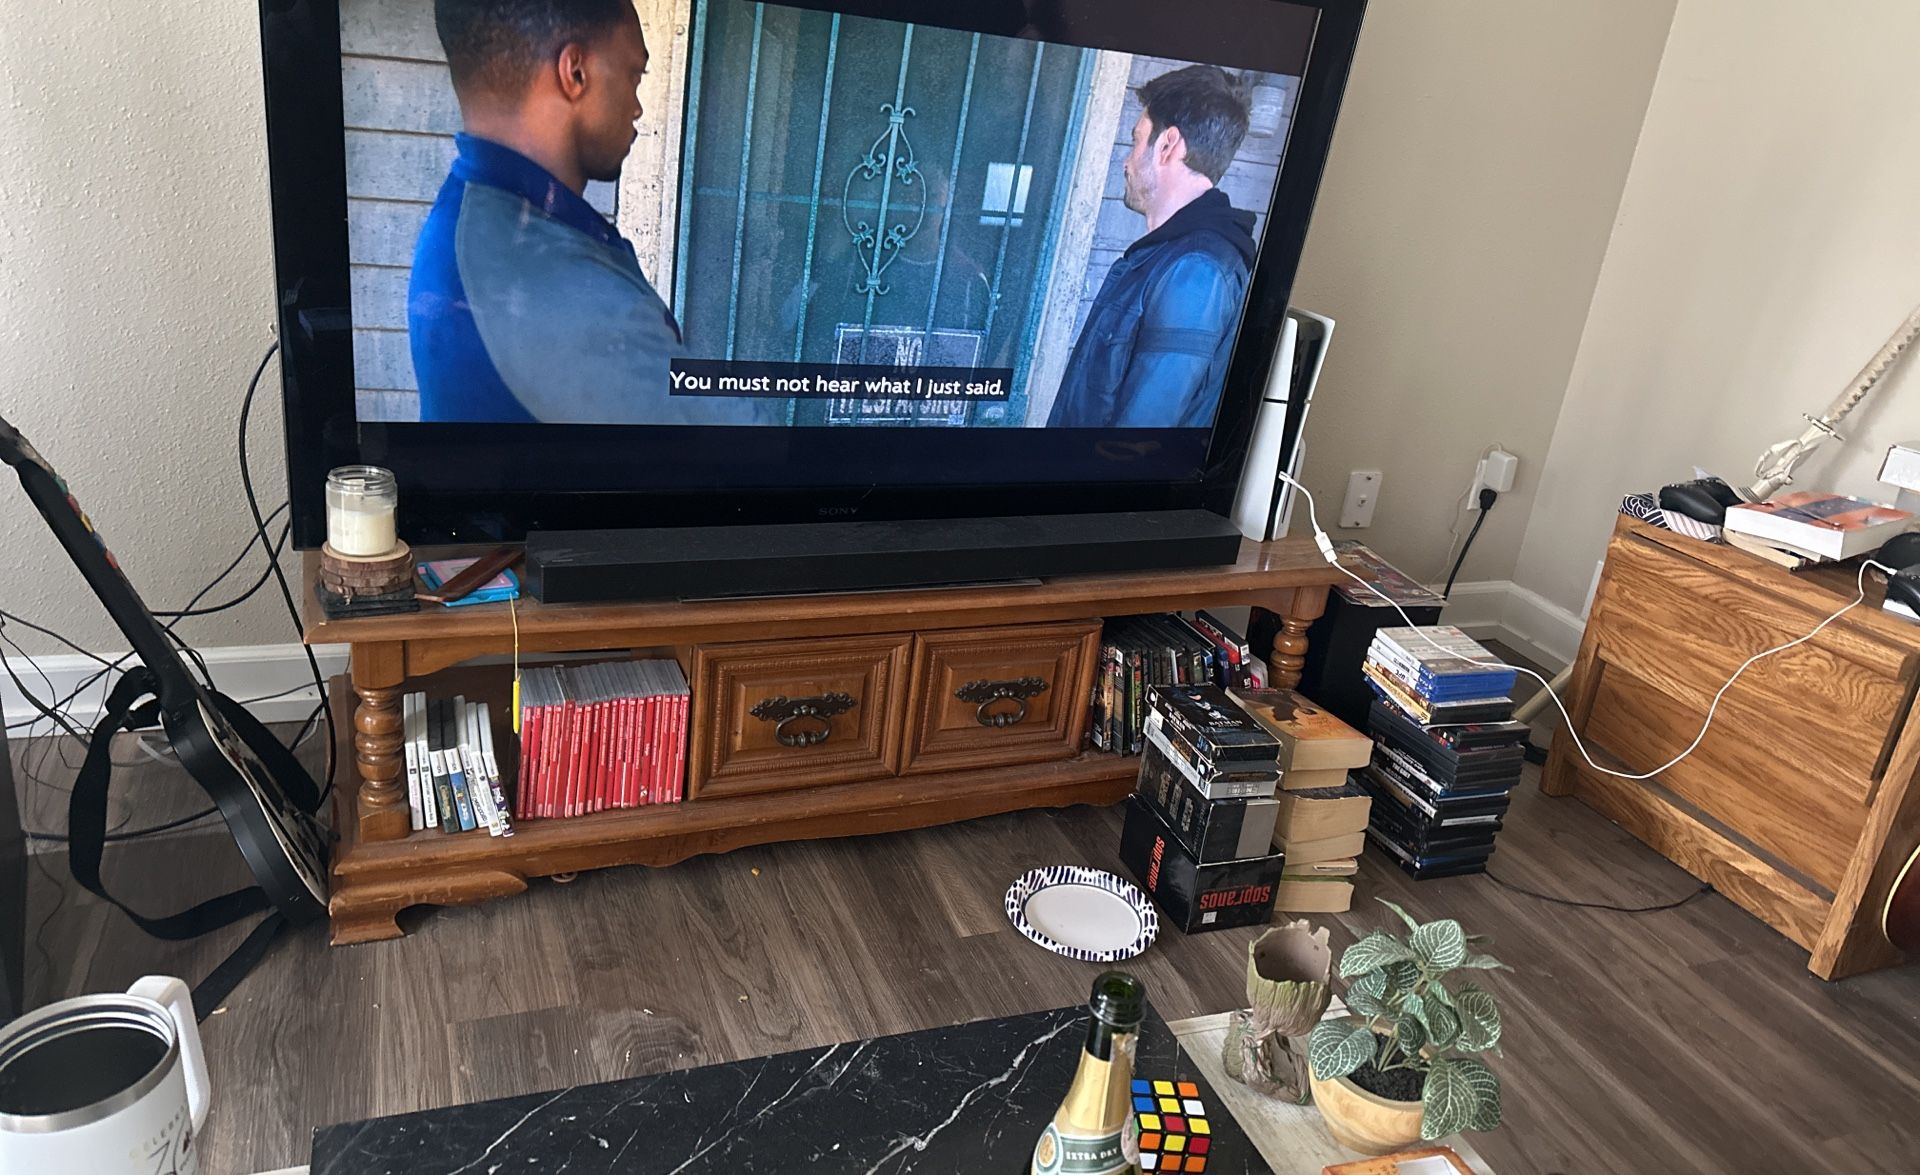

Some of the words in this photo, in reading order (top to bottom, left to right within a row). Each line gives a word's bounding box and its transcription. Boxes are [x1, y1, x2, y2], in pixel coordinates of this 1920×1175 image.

[894, 337, 923, 374] NO
[669, 371, 711, 390] You
[718, 376, 770, 391] must
[776, 376, 810, 392] not
[816, 375, 859, 393] hear
[865, 377, 911, 394] what
[916, 378, 922, 394] I
[925, 379, 961, 398] just
[965, 379, 1004, 396] said.
[817, 506, 858, 516] SONY
[1147, 836, 1166, 892] sopranos
[1199, 886, 1271, 910] sopranos
[1065, 1151, 1098, 1161] EXTRA
[1100, 1147, 1118, 1159] DRY
